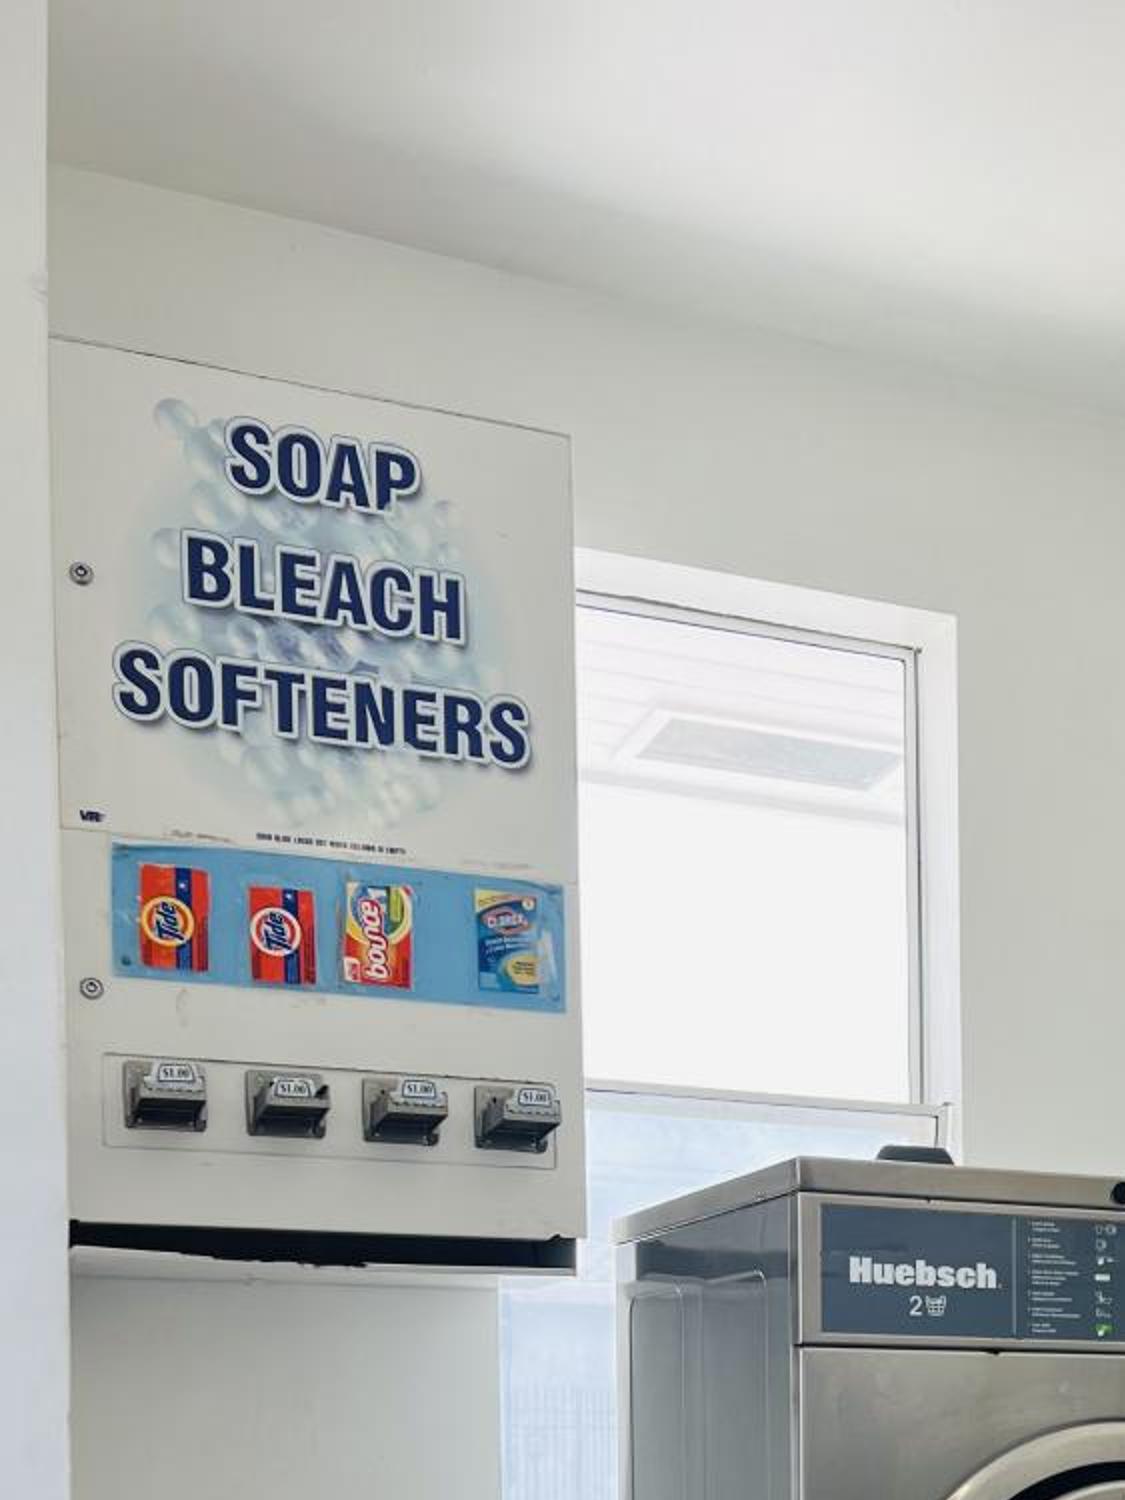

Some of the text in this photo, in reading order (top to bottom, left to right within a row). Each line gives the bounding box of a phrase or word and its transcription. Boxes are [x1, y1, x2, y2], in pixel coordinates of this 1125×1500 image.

[228, 421, 418, 511] SOAP
[185, 535, 464, 642] BLEACH
[116, 646, 528, 766] SOFTENERS
[155, 901, 184, 942] Tide
[264, 911, 292, 951] Tide
[849, 1256, 998, 1289] Huebsch
[909, 1295, 923, 1316] 2
